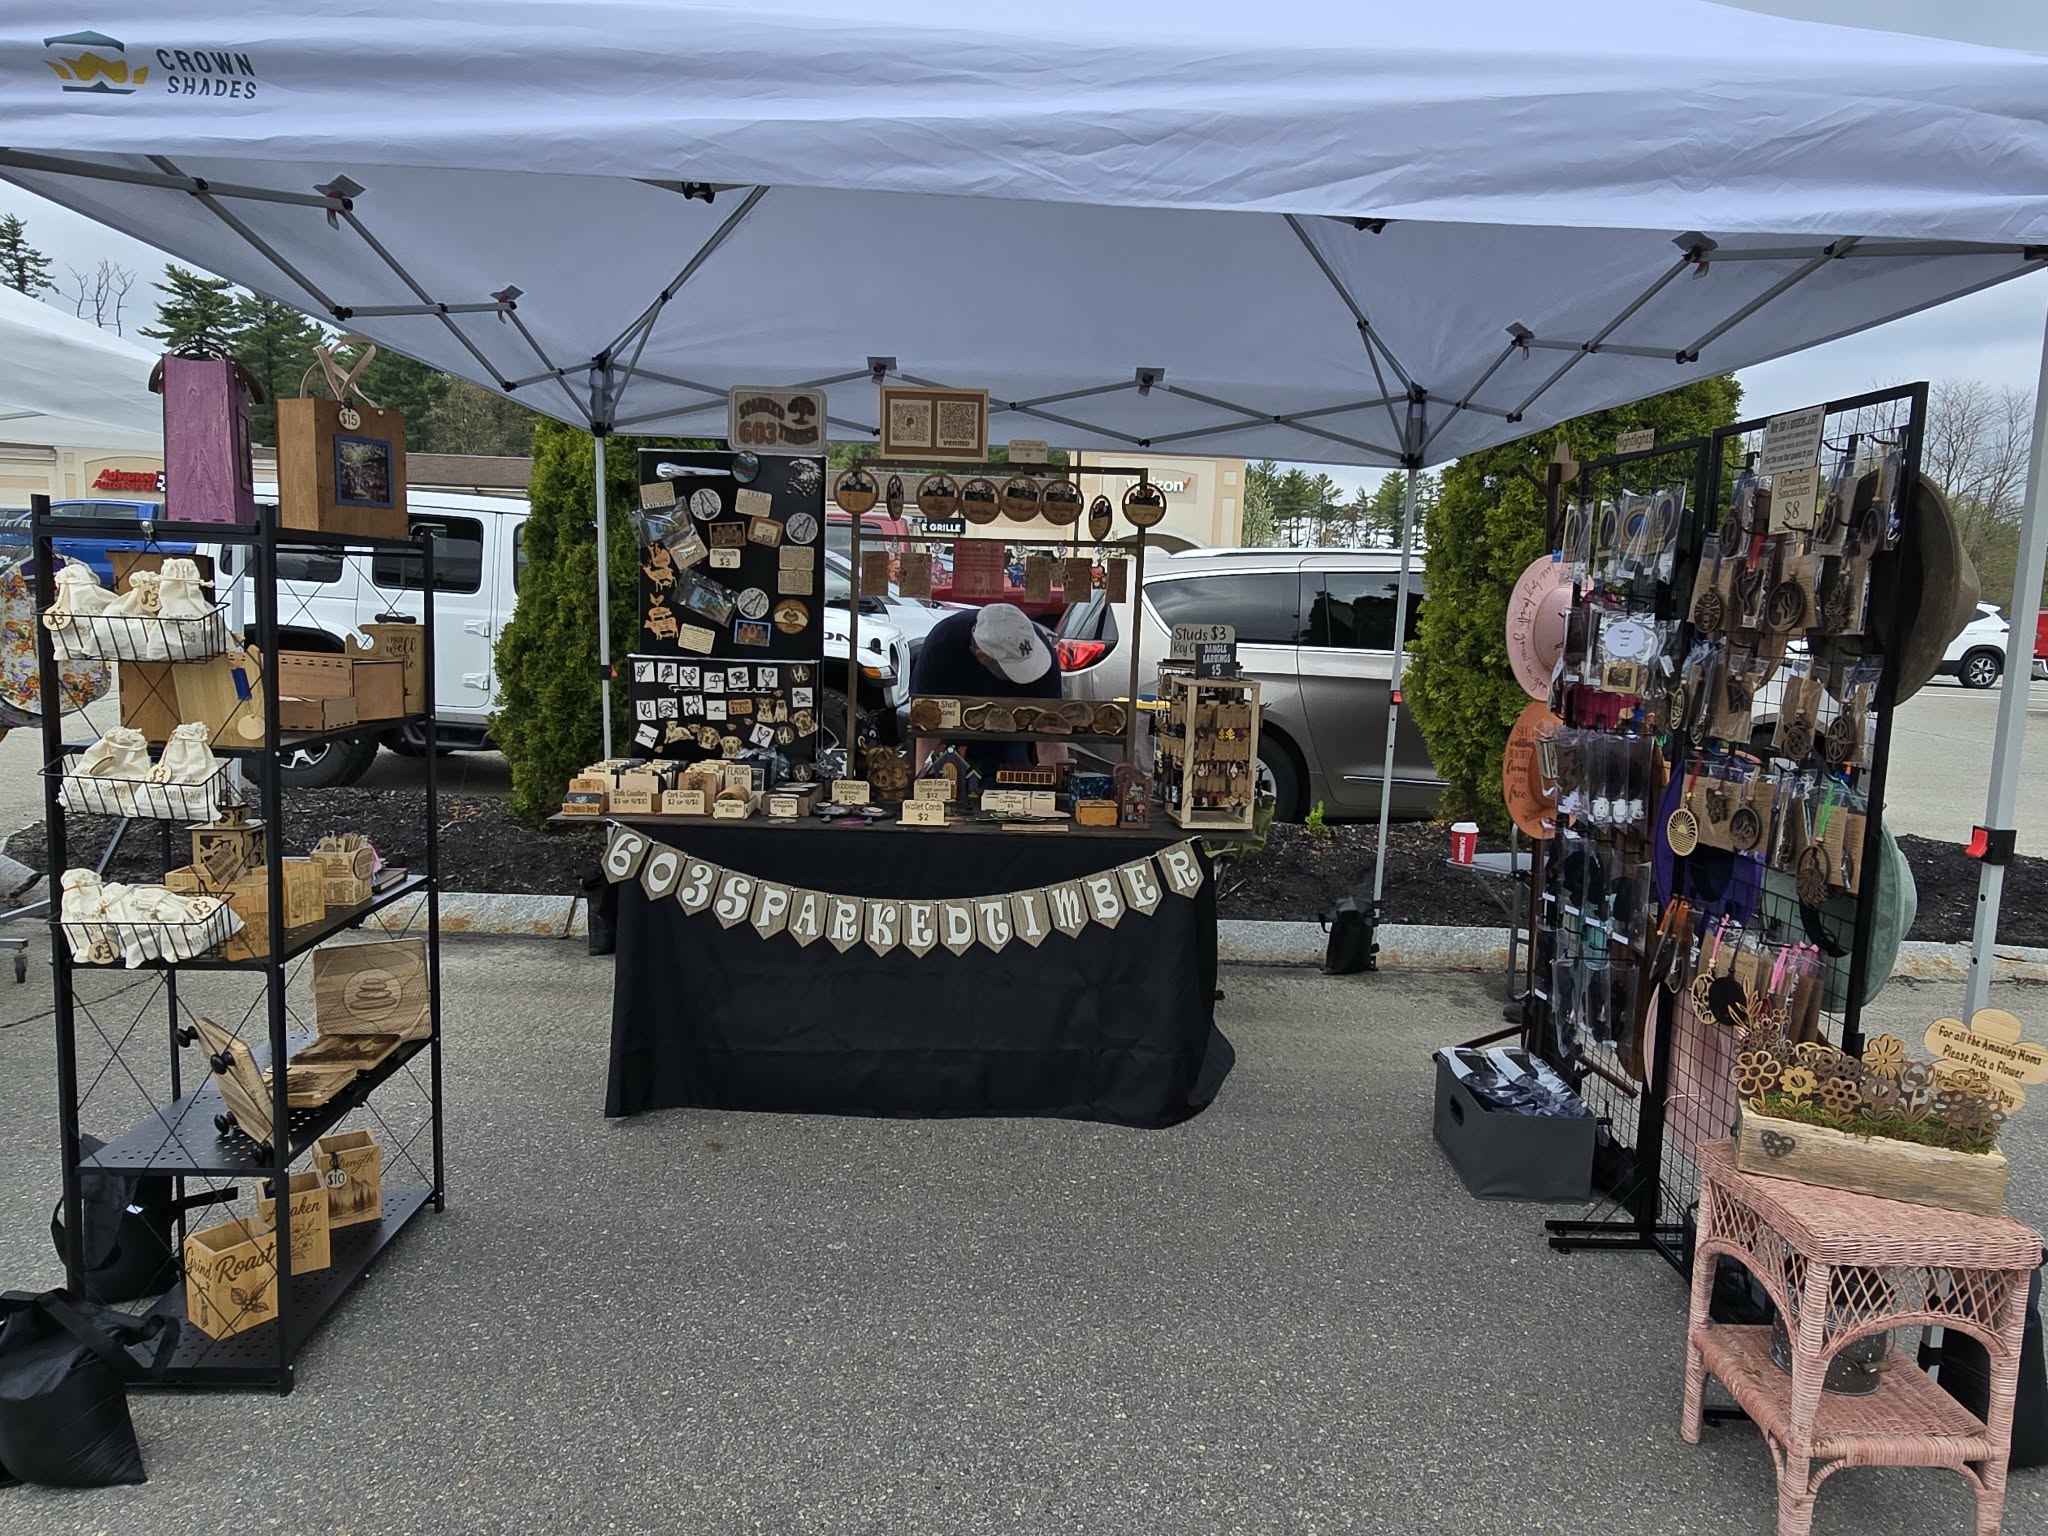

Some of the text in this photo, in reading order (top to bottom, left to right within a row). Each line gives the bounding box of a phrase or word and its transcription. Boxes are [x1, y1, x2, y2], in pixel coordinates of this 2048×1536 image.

[156, 48, 256, 77] CROWN
[167, 75, 257, 100] SHADES
[341, 412, 358, 427] $15
[739, 421, 778, 445] 603
[943, 439, 970, 447] venmo
[98, 468, 157, 482] Advance
[1784, 500, 1801, 521] $8
[929, 524, 961, 532] GRILLE
[719, 557, 731, 567] $3
[141, 591, 159, 607] $3
[48, 612, 65, 626] $3
[1174, 626, 1226, 641] Studs $3
[385, 636, 417, 657] well
[1173, 642, 1187, 657] Key
[1204, 644, 1228, 653] DANGLE
[1202, 653, 1231, 664] EARRINGS
[1211, 663, 1221, 676] $5
[150, 769, 166, 783] $3
[727, 767, 750, 777] FLASKS
[733, 776, 743, 785] $10
[834, 782, 868, 791] Bobblehead
[933, 780, 949, 788] Fairy
[666, 791, 679, 799] Cork
[667, 798, 675, 806] $2
[904, 802, 943, 811] Wallet Cards
[917, 813, 929, 822] $2
[192, 900, 212, 916] $3
[94, 944, 112, 960] $3
[1938, 1025, 2042, 1066] For all the Amazing Moms
[1942, 1044, 2025, 1080] Please Pick a Flower
[1997, 1089, 2016, 1108] Day
[326, 1173, 346, 1186] $10
[264, 1195, 322, 1223] Aaken
[185, 1246, 213, 1282] Grind
[215, 1242, 277, 1284] Roast
